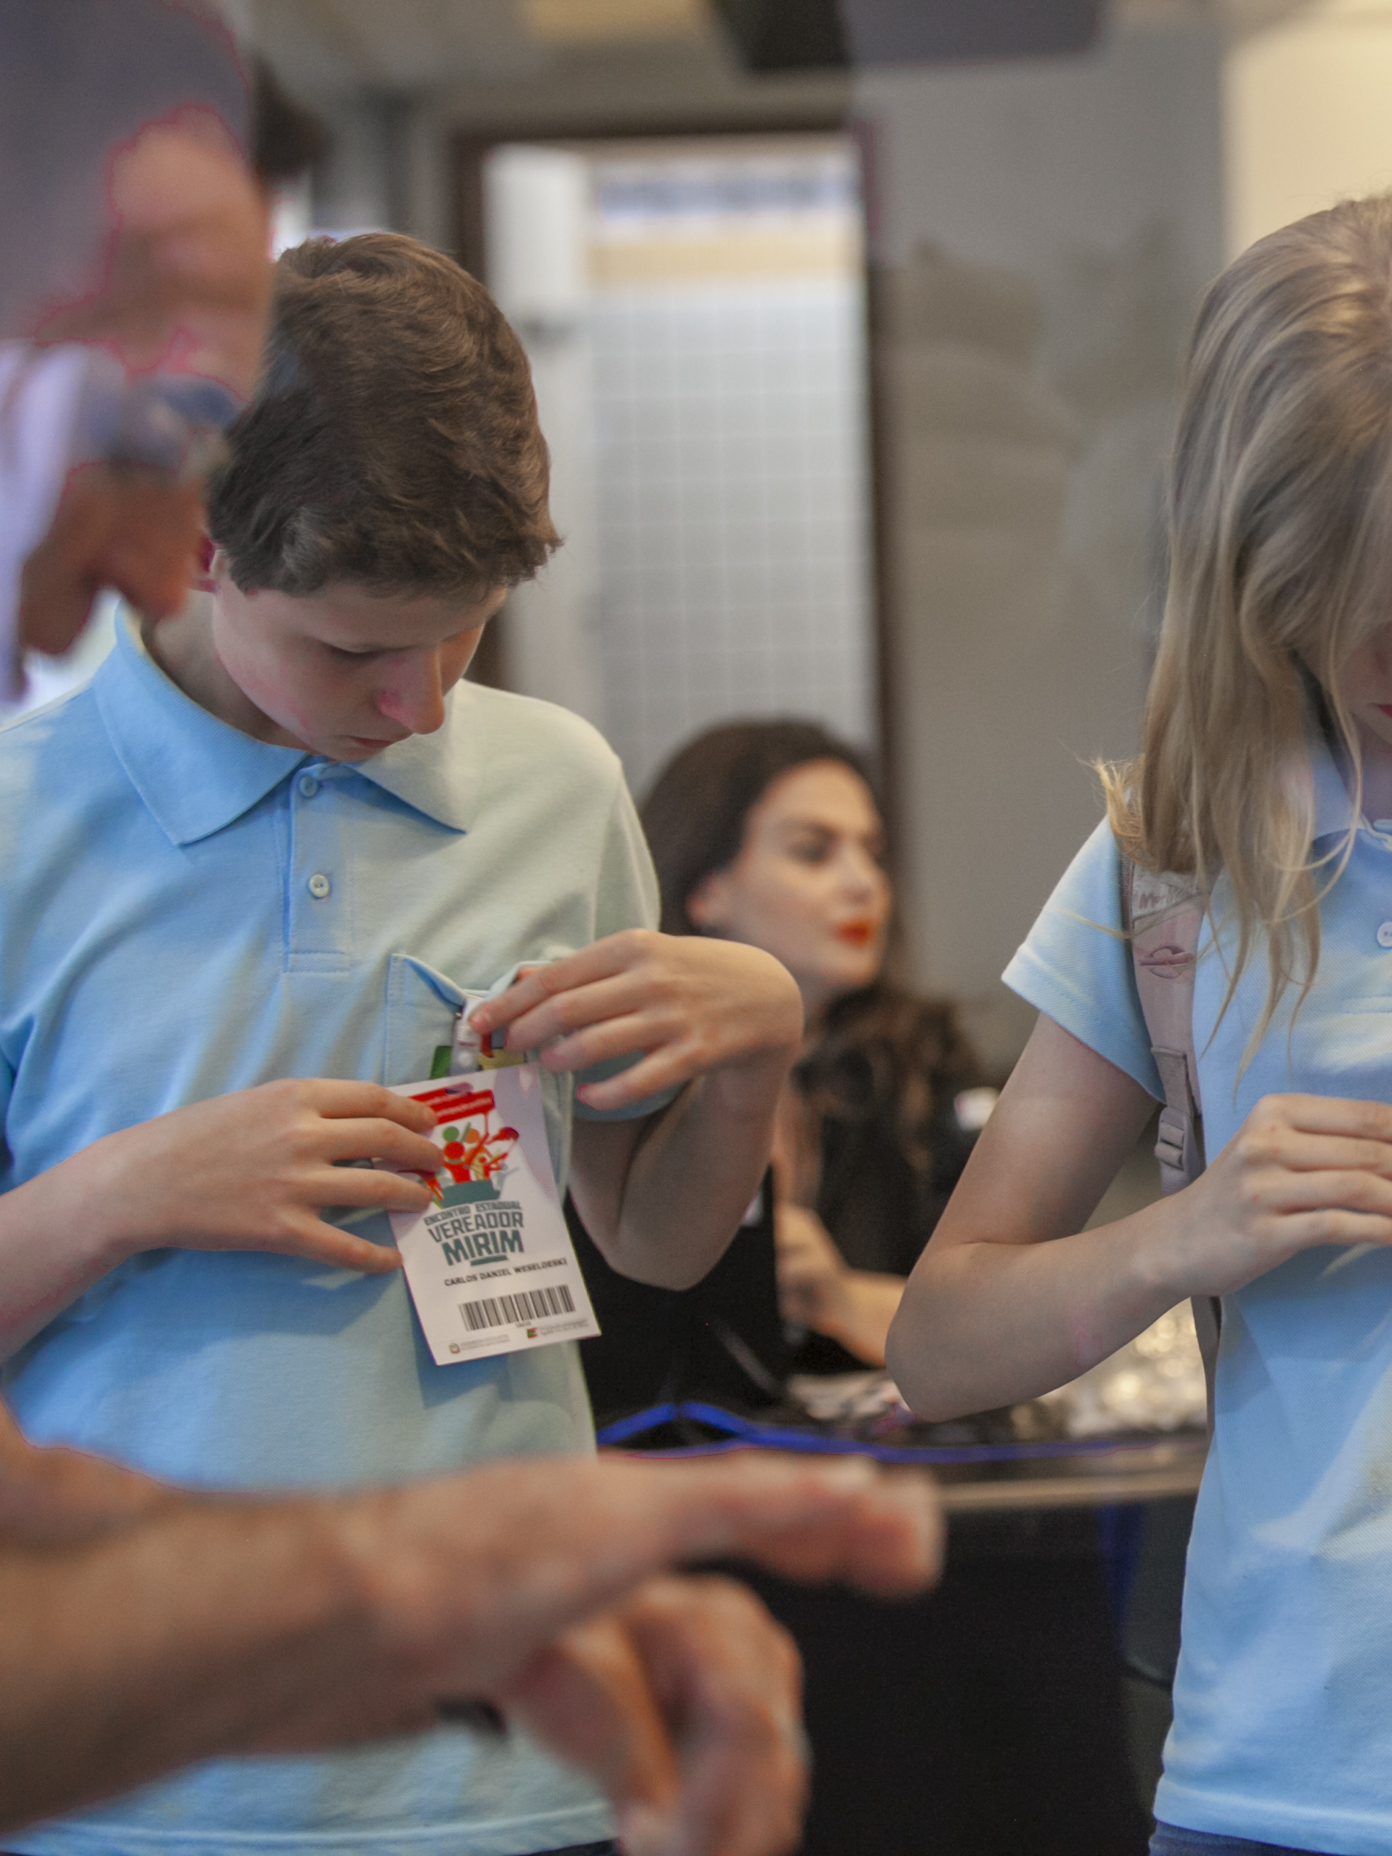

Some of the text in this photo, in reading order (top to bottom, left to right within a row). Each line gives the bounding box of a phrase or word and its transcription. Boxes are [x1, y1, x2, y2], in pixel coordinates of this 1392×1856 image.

[423, 1200, 522, 1226] ENCONTRO ESTADUAL
[427, 1211, 524, 1243] VEREADOR
[442, 1229, 524, 1266] MIRIM
[444, 1274, 478, 1287] CARLOS
[480, 1268, 512, 1280] DANIEL
